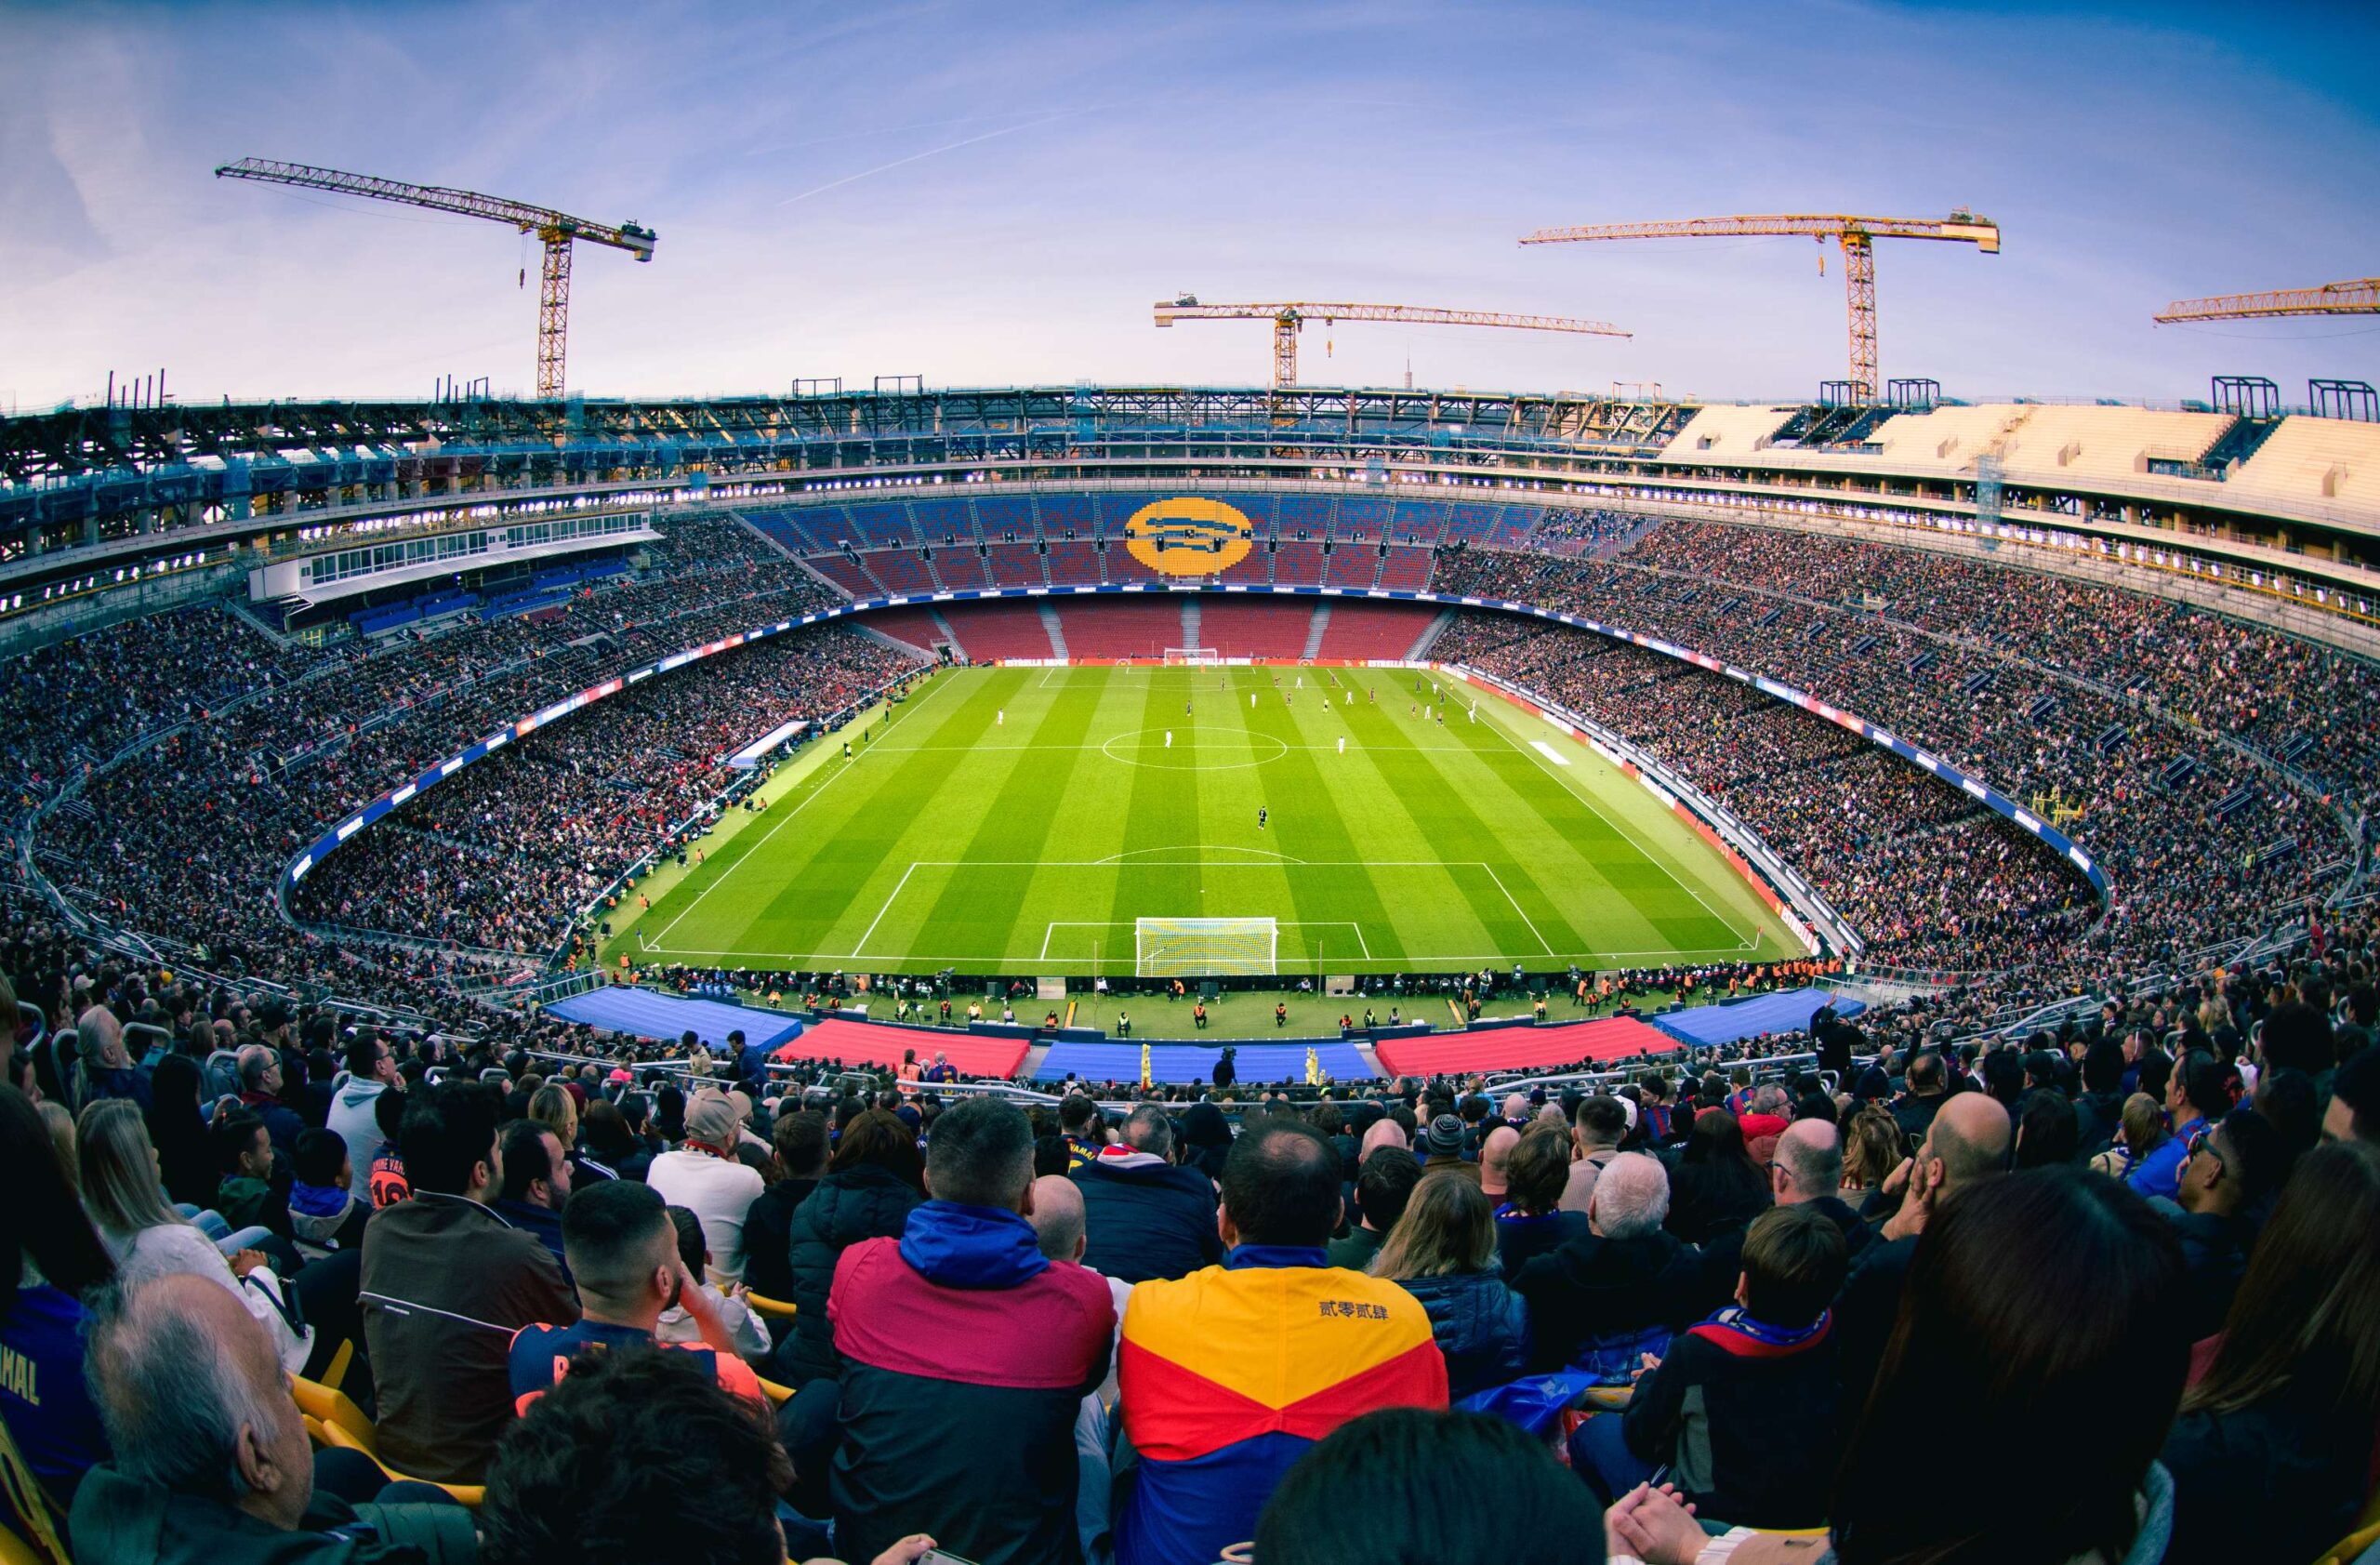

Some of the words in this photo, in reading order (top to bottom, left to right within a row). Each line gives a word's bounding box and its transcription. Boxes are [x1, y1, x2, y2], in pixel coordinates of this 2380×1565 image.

[1318, 1300, 1389, 1320] 贰零贰肆
[0, 1344, 40, 1407] MAL
